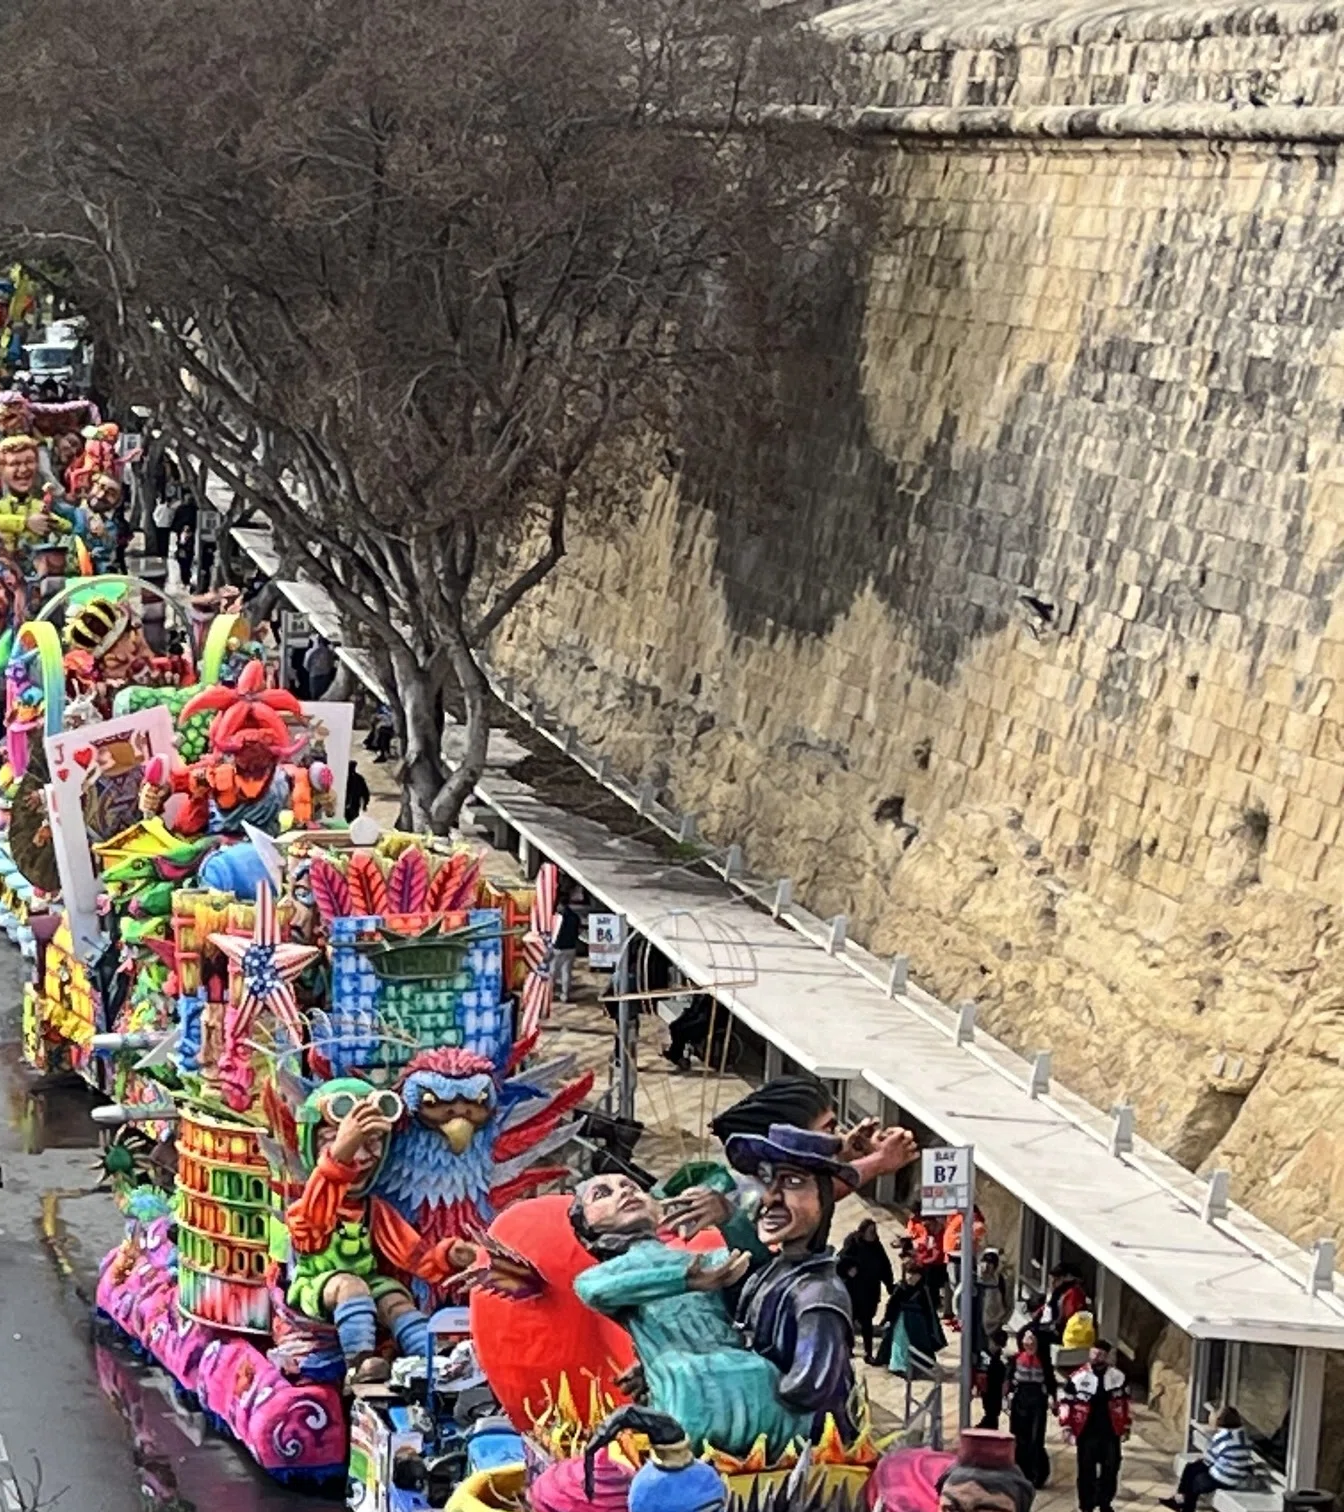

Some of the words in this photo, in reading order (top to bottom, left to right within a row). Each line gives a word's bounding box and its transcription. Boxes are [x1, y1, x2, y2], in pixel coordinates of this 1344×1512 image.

[53, 743, 65, 765] J
[596, 927, 612, 942] B6
[935, 1151, 957, 1161] BAY
[934, 1165, 957, 1183] B7
